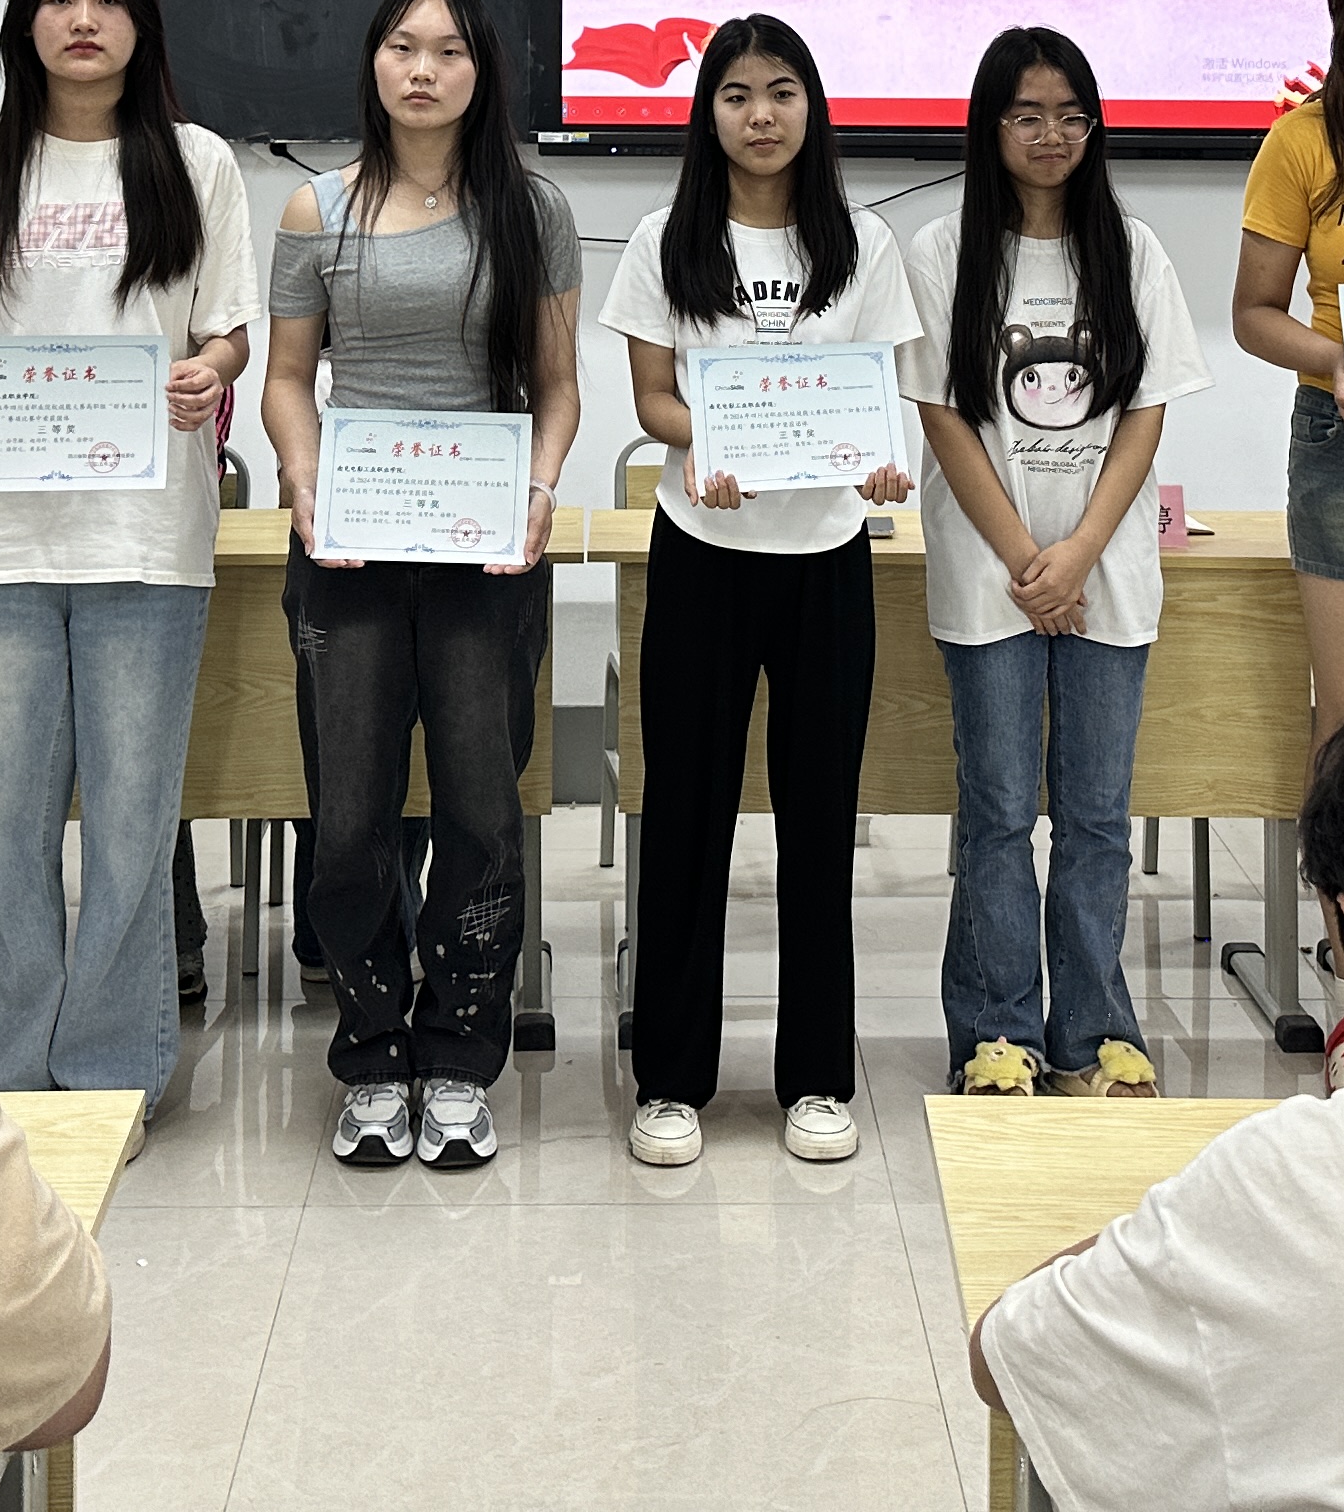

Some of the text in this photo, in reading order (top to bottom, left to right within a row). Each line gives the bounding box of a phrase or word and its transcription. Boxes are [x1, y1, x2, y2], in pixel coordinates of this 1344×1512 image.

[1232, 58, 1287, 69] Windows
[22, 366, 97, 383] 荣誉证书
[759, 374, 828, 392] 荣誉证书
[392, 441, 462, 458] 荣誉证书
